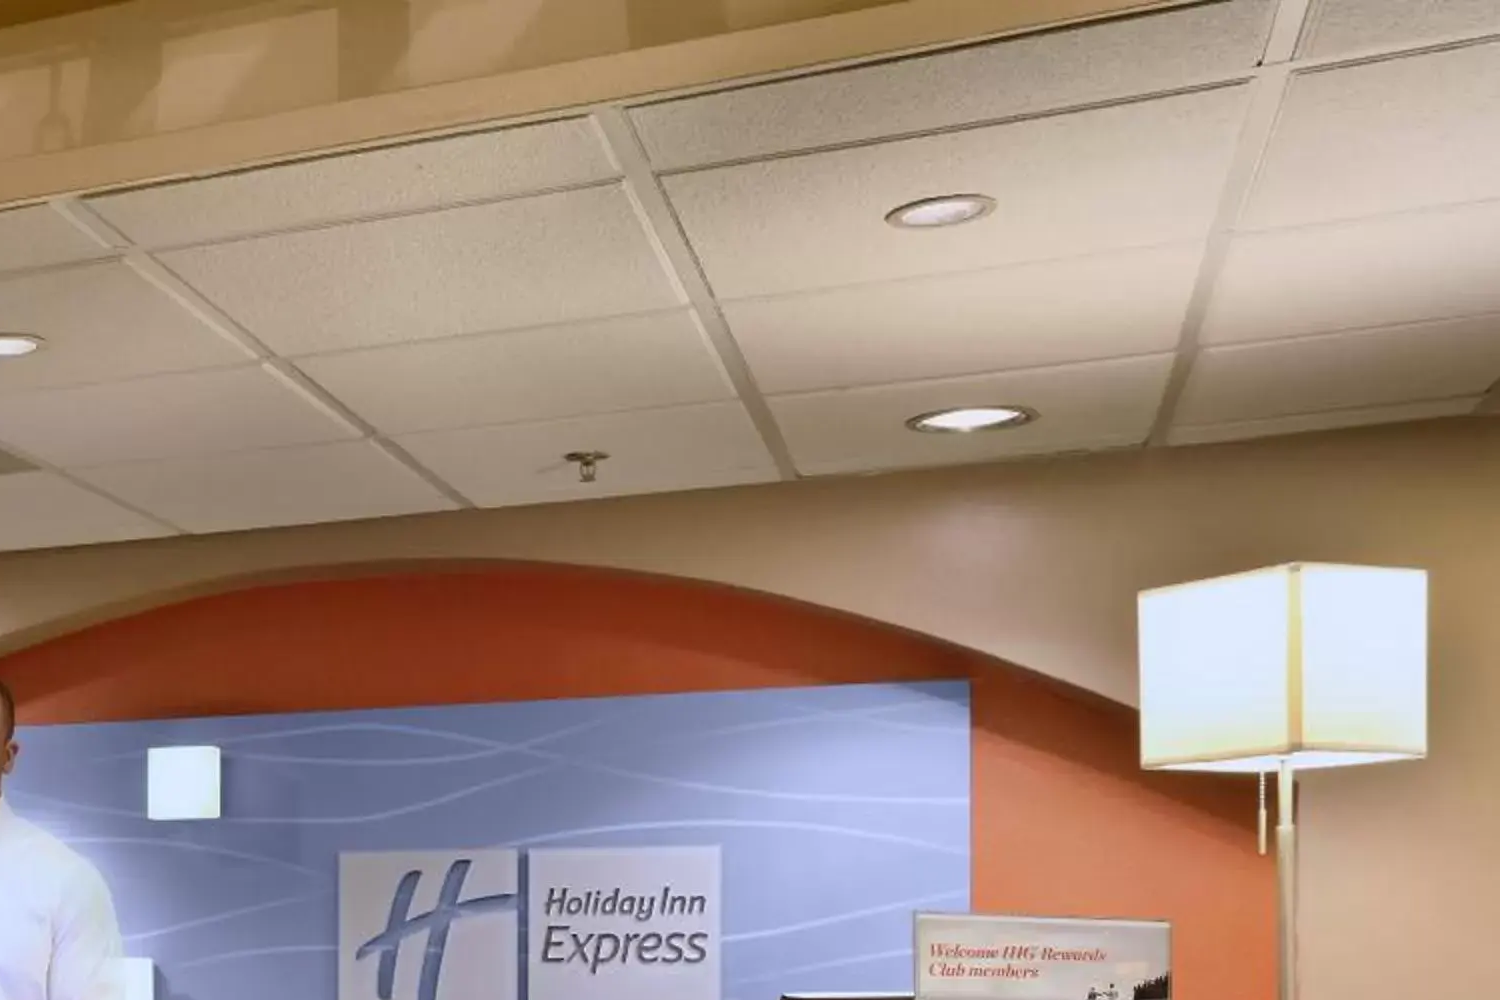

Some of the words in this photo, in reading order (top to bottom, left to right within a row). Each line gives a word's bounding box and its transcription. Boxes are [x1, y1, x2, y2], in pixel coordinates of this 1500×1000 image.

[544, 887, 655, 921] Holiday
[660, 887, 707, 916] Inn
[541, 925, 708, 974] Express
[929, 942, 999, 960] Welcome
[1040, 946, 1108, 962] Rewards
[929, 962, 966, 978] Club
[968, 963, 1040, 979] members
